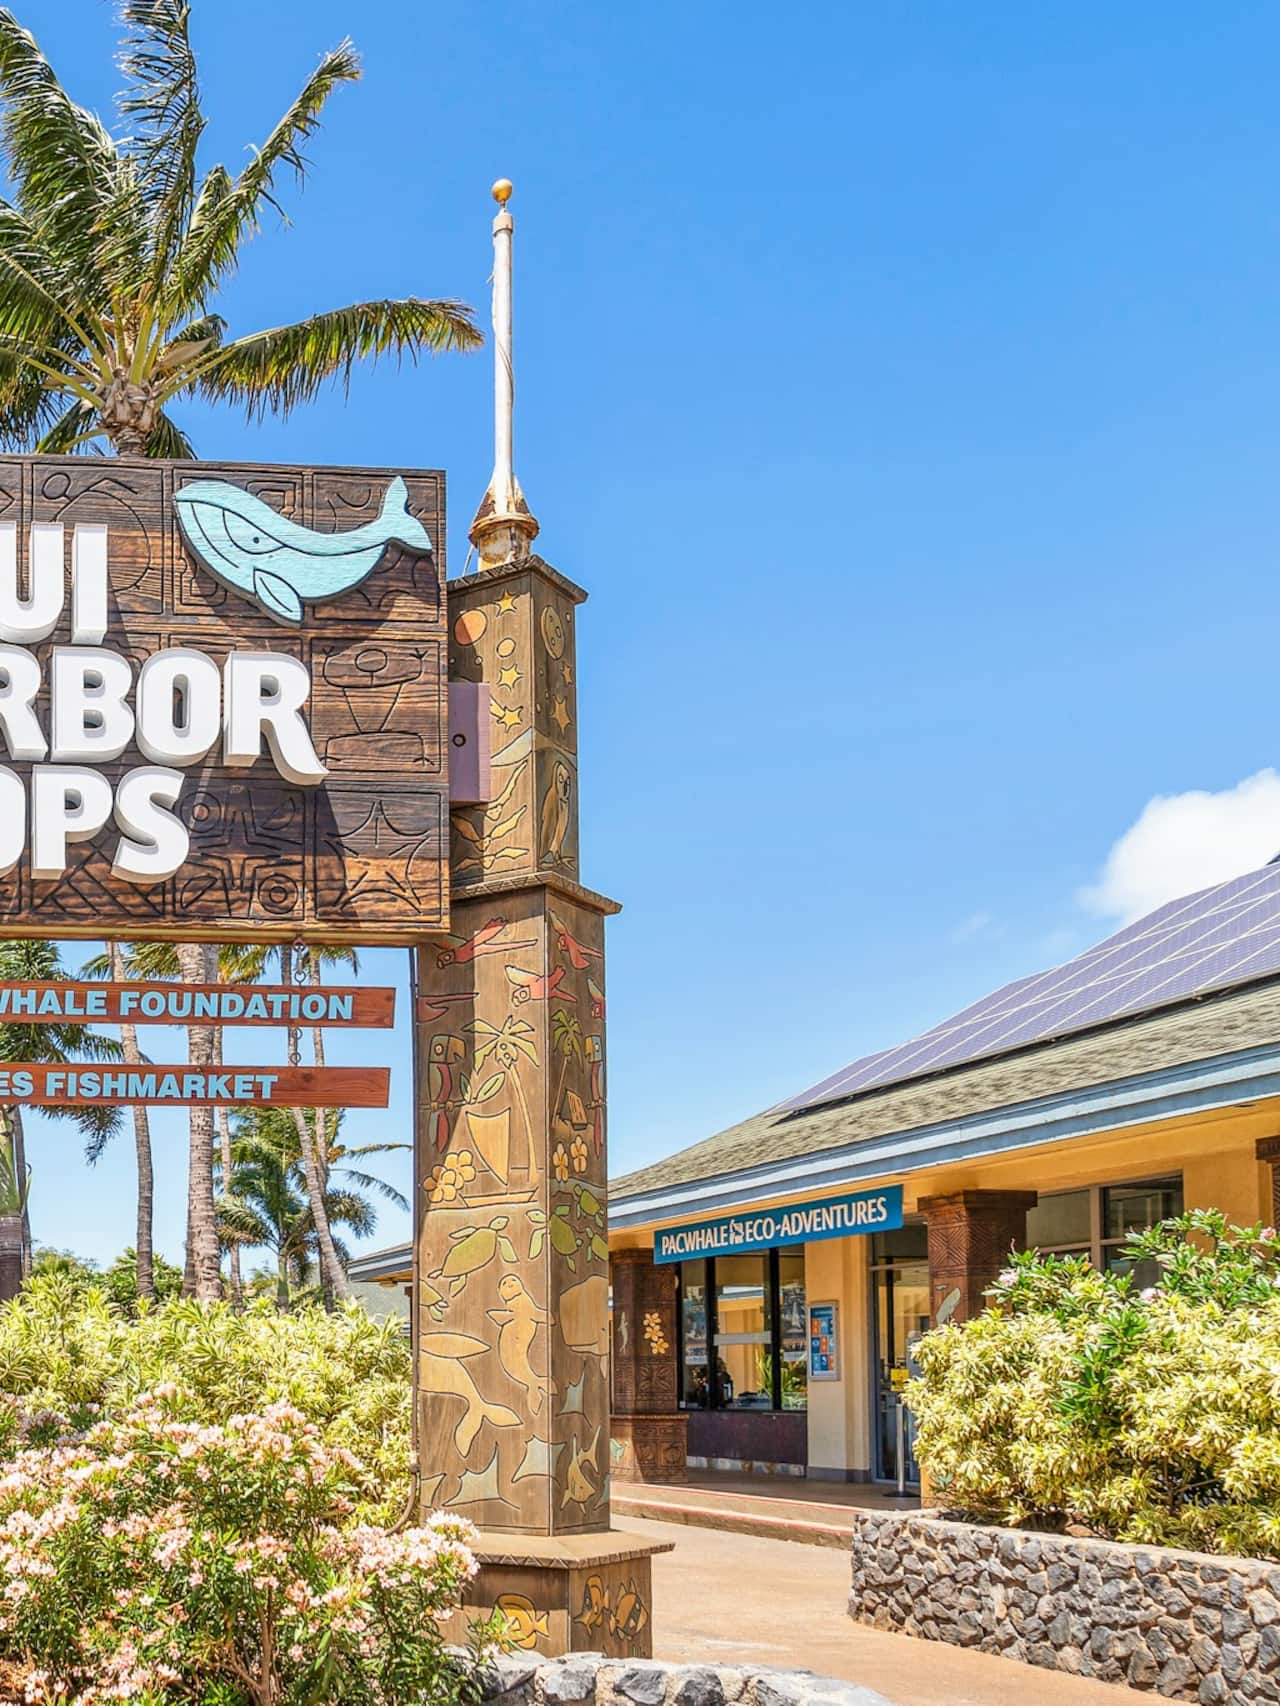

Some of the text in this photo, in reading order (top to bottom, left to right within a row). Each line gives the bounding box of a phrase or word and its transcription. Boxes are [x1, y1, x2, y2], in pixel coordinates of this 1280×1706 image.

[119, 990, 354, 1020] FOUNDATION
[45, 1071, 278, 1101] FISHMARKET
[661, 1196, 888, 1256] PACWHALE ECO-ADVENTURES
